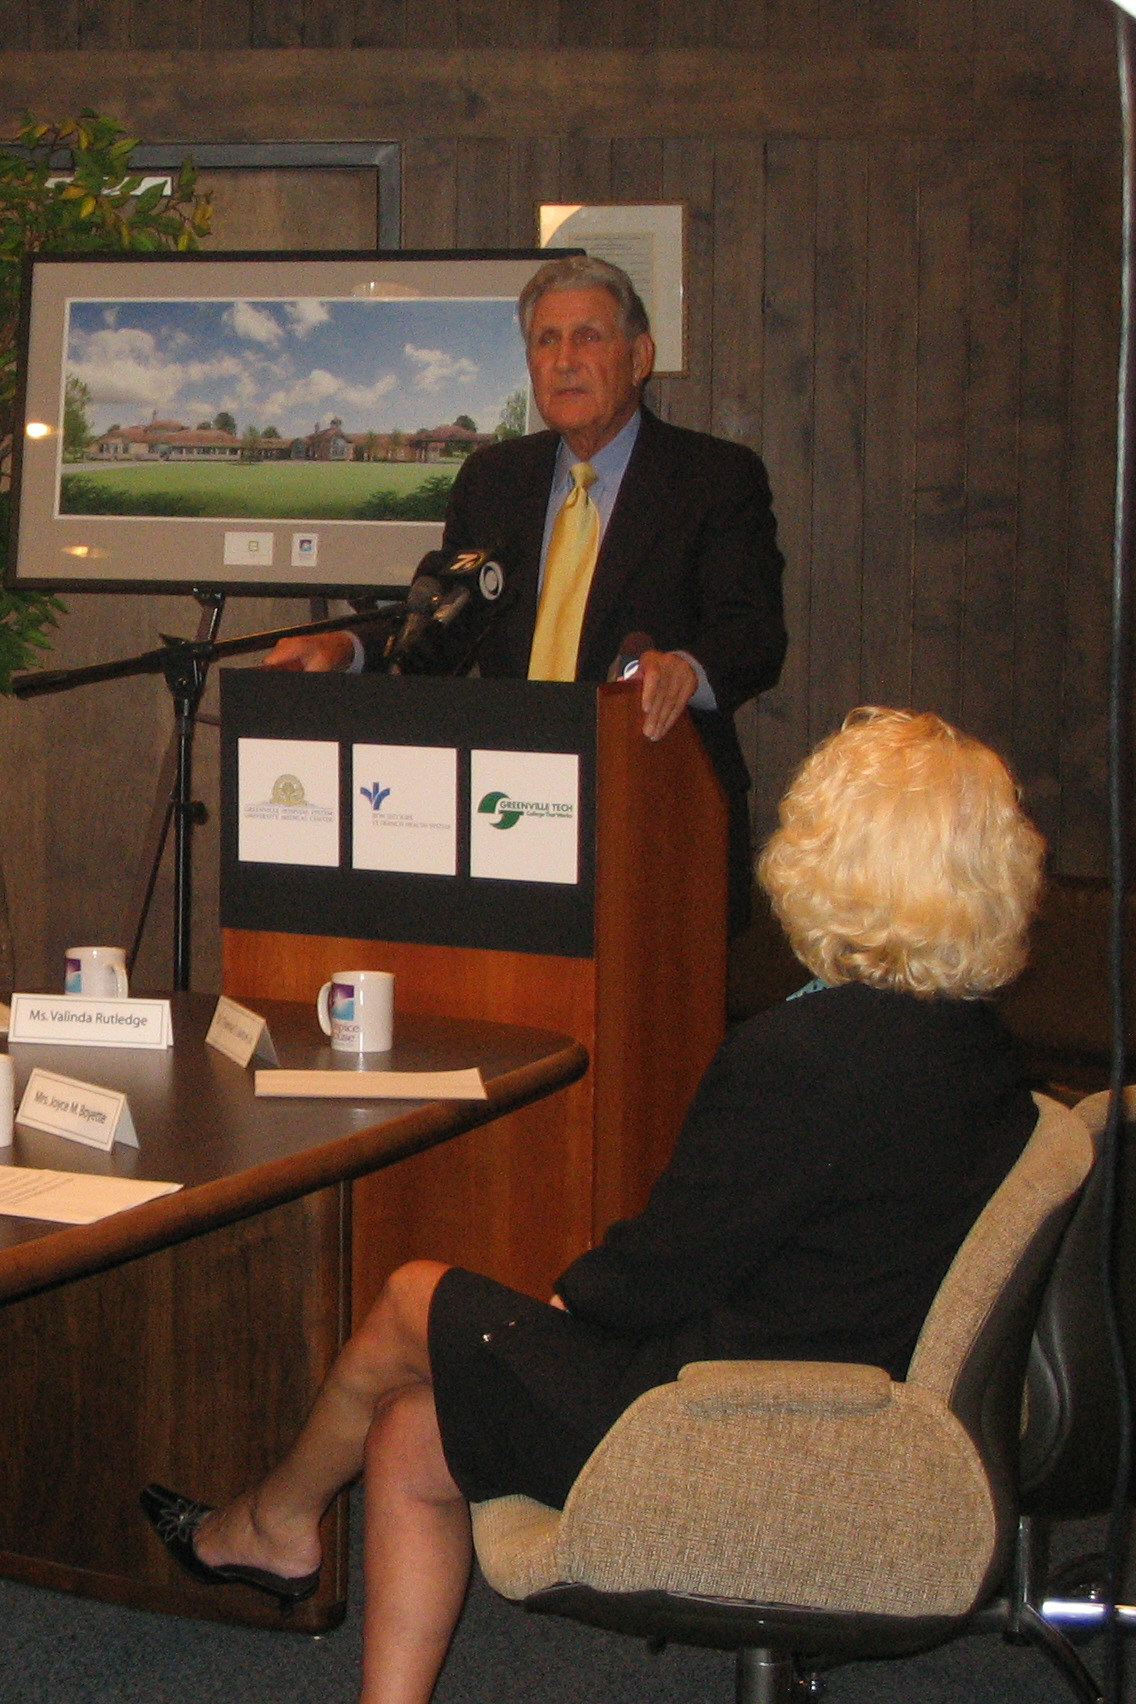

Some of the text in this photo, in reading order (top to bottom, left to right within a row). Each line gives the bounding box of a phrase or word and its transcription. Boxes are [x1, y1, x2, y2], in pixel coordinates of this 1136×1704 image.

[500, 800, 573, 812] GREENVILLE TECH
[29, 1009, 148, 1028] Ms. Valinda Rutledge
[49, 1095, 69, 1113] Joyce
